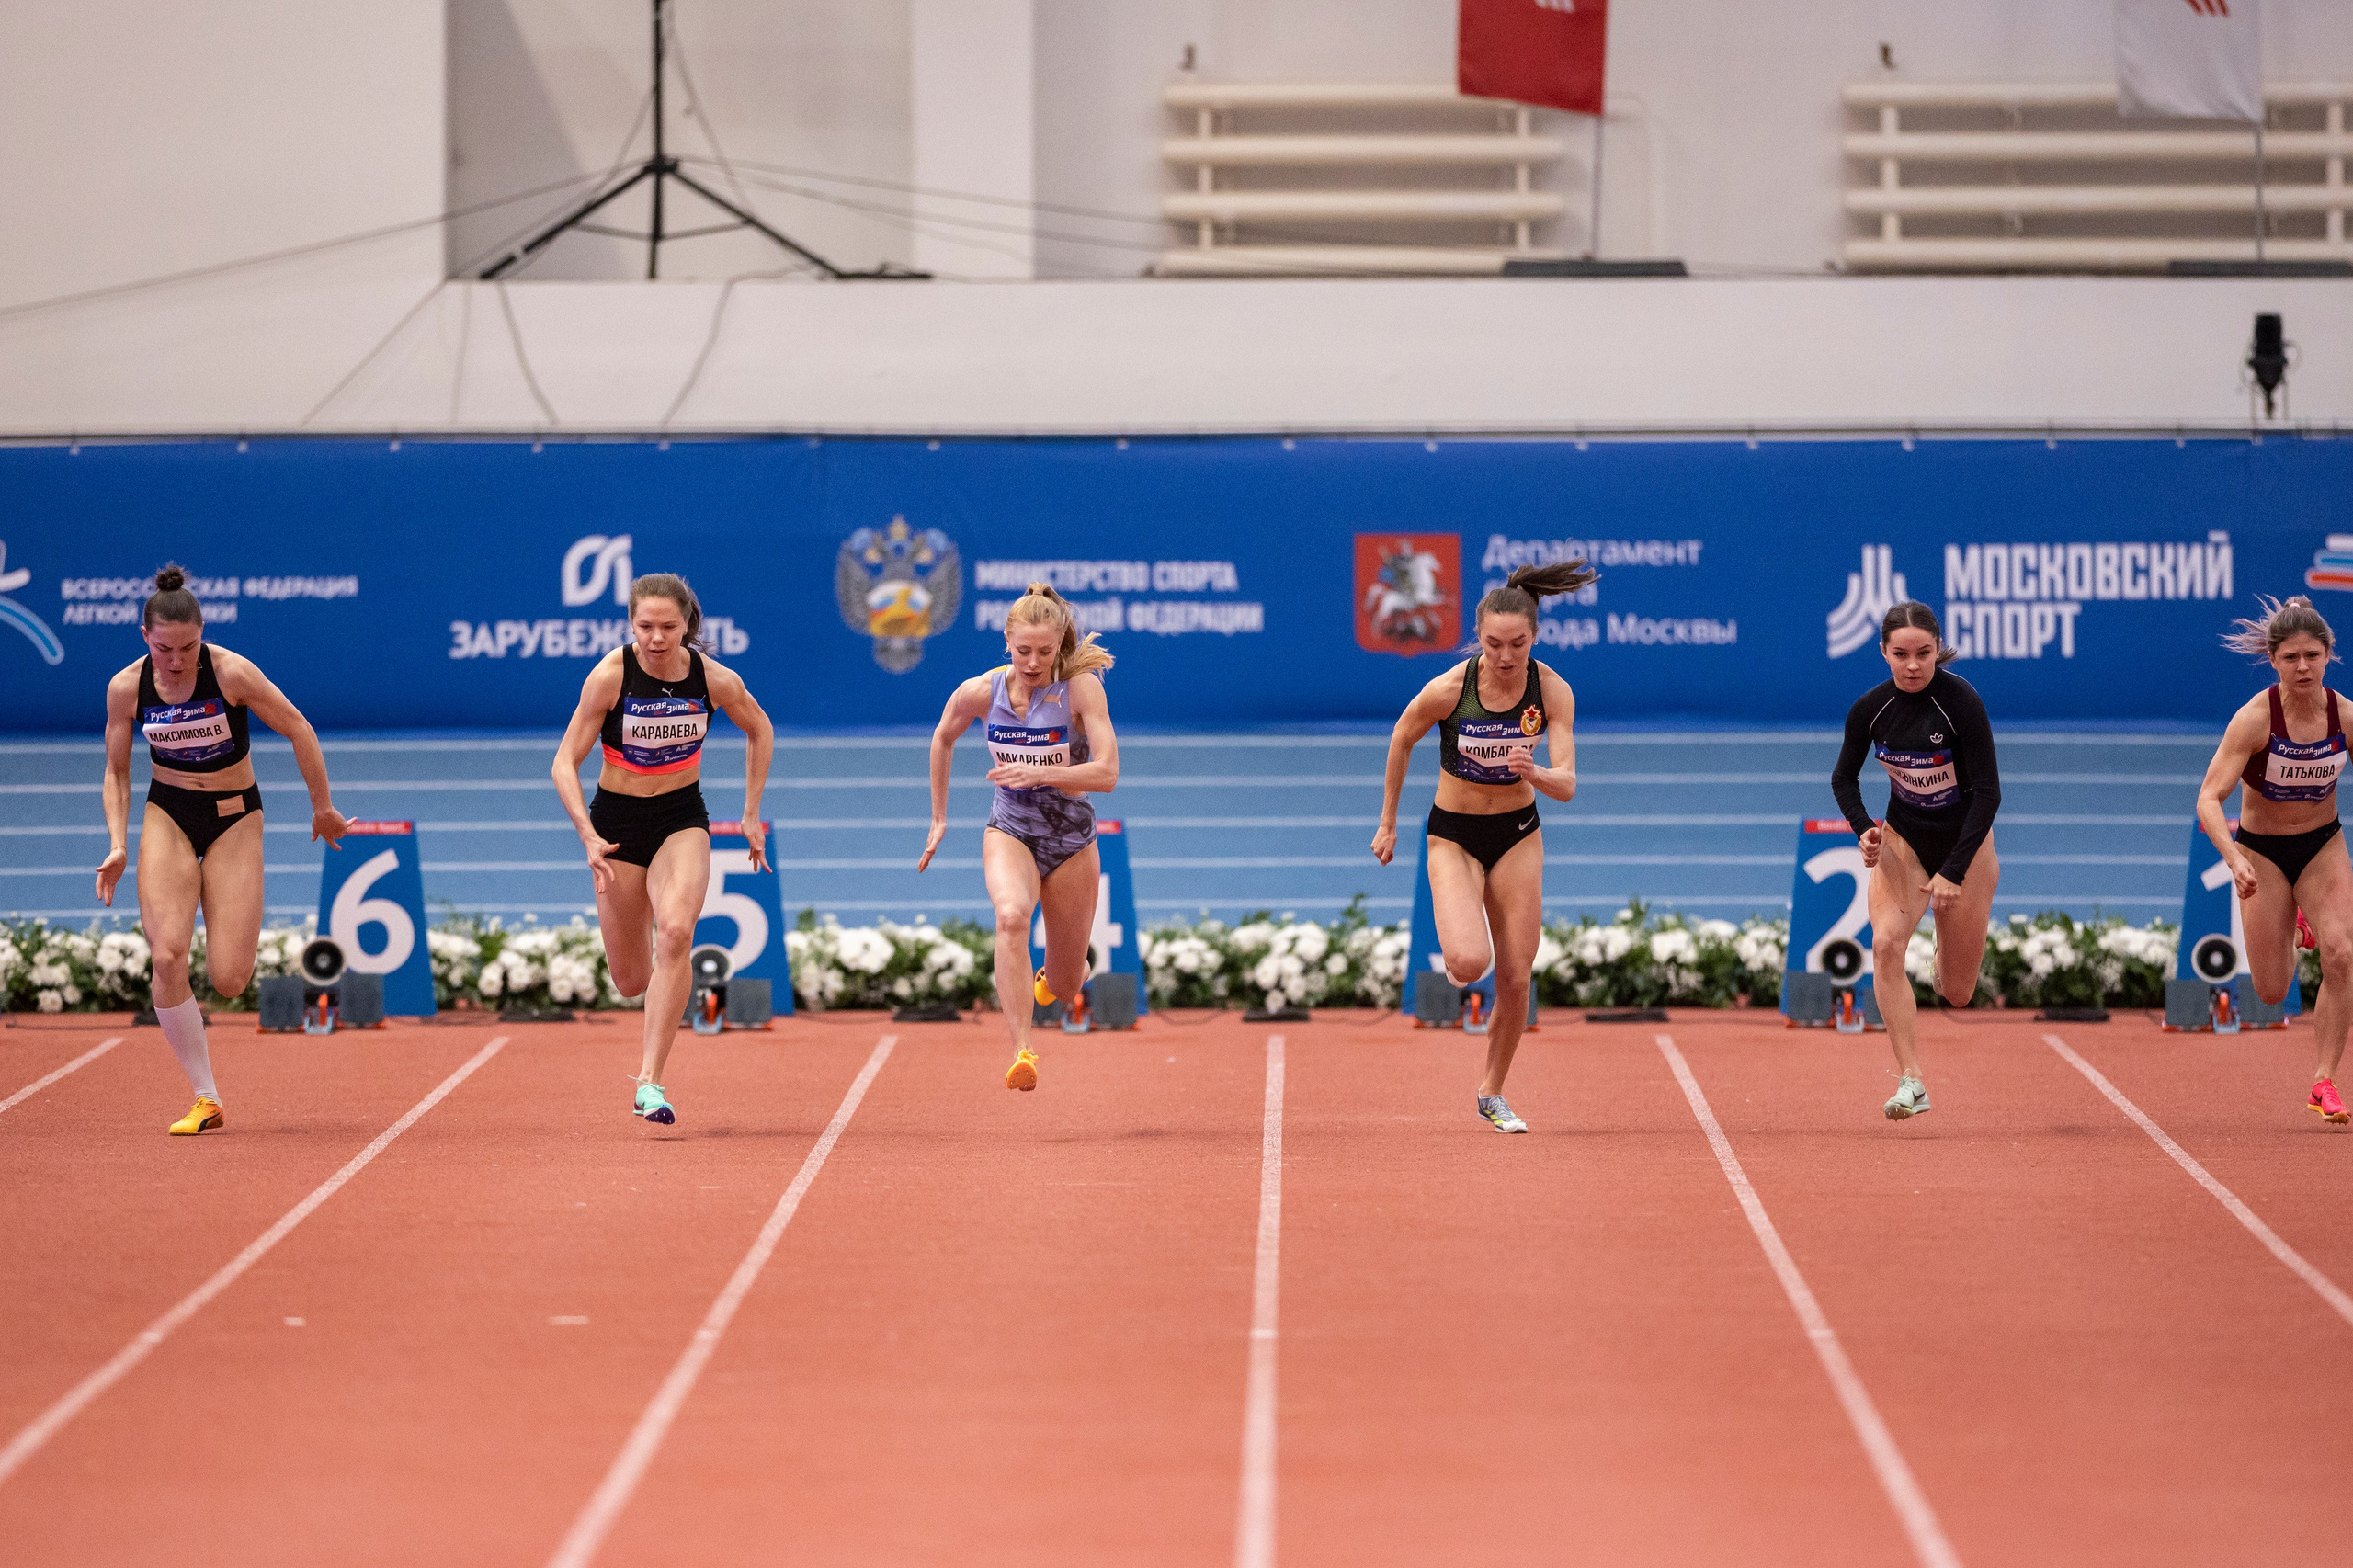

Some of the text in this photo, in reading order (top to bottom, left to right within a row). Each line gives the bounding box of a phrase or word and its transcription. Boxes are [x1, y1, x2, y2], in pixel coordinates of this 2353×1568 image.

[1482, 534, 1701, 572] Департамент
[1944, 529, 2234, 599] МОСКОВСКИЙ
[243, 575, 359, 599] ФЕДЕРАЦИЯ
[974, 561, 1238, 592] МИНИСТЕРСТВО СПОРТА
[1127, 601, 1265, 636] ФЕДЕРАЦИИ
[1608, 612, 1738, 644] Москвы
[1944, 600, 2082, 659] СПОРТ
[151, 707, 206, 722] Русская Зима
[631, 701, 666, 714] Русская
[666, 703, 689, 714] Зима
[149, 724, 225, 743] МАКСИМОВА В.
[631, 723, 698, 740] КАРАВАЕВА
[994, 731, 1027, 741] Русская
[1026, 733, 1050, 744] Зима
[1466, 724, 1503, 735] Русская
[1879, 751, 1934, 767] Русская Зима
[2278, 744, 2332, 758] Русская Зима
[2280, 764, 2336, 779] ТАТЬКОВА
[330, 847, 415, 974] 6
[704, 849, 769, 973] 5
[1802, 846, 1875, 974] 2
